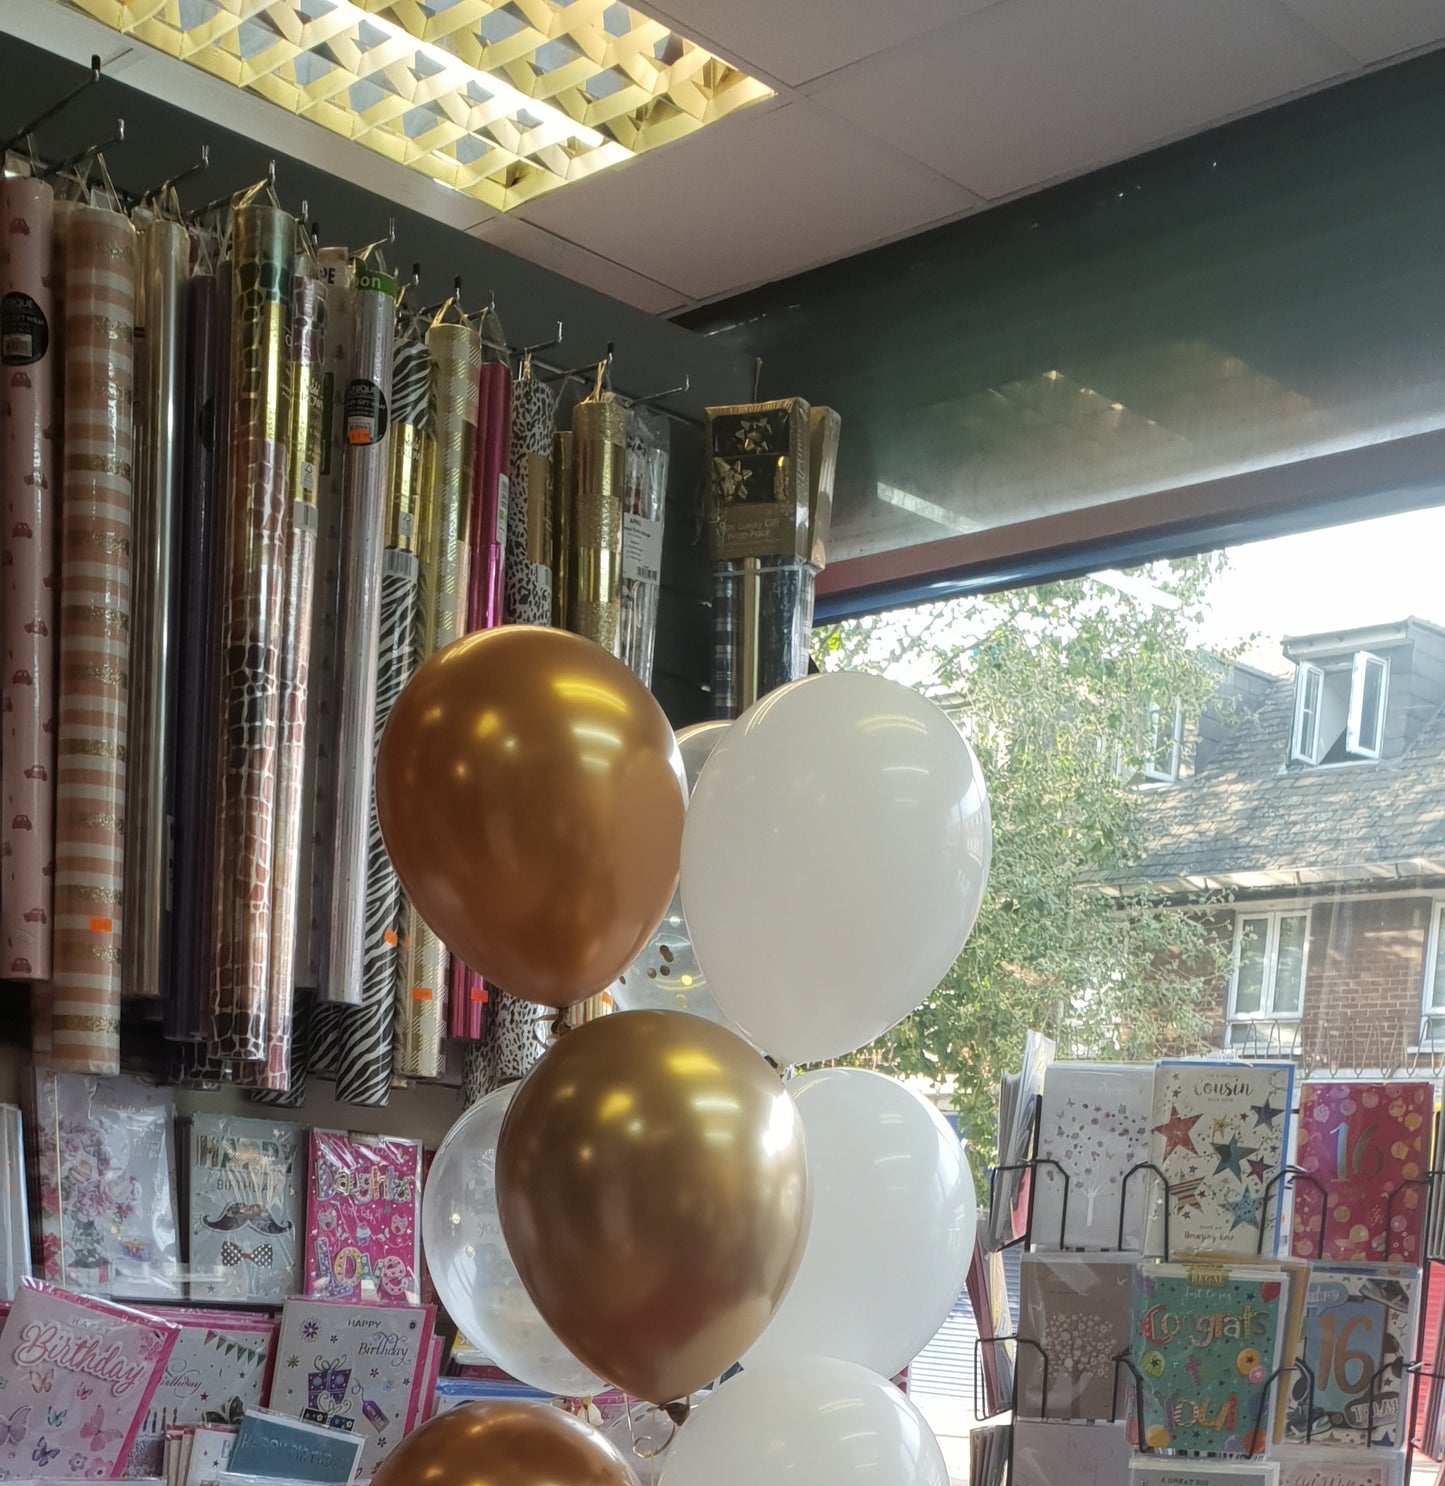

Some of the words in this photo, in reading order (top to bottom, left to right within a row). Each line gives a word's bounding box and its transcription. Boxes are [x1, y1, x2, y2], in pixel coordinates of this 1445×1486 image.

[1329, 1122, 1384, 1181] 16
[347, 1319, 382, 1330] HAPPY
[358, 1332, 412, 1366] Birthday
[1142, 1304, 1267, 1348] Congrats
[21, 1323, 143, 1392] Birthday
[1317, 1313, 1376, 1394] 16
